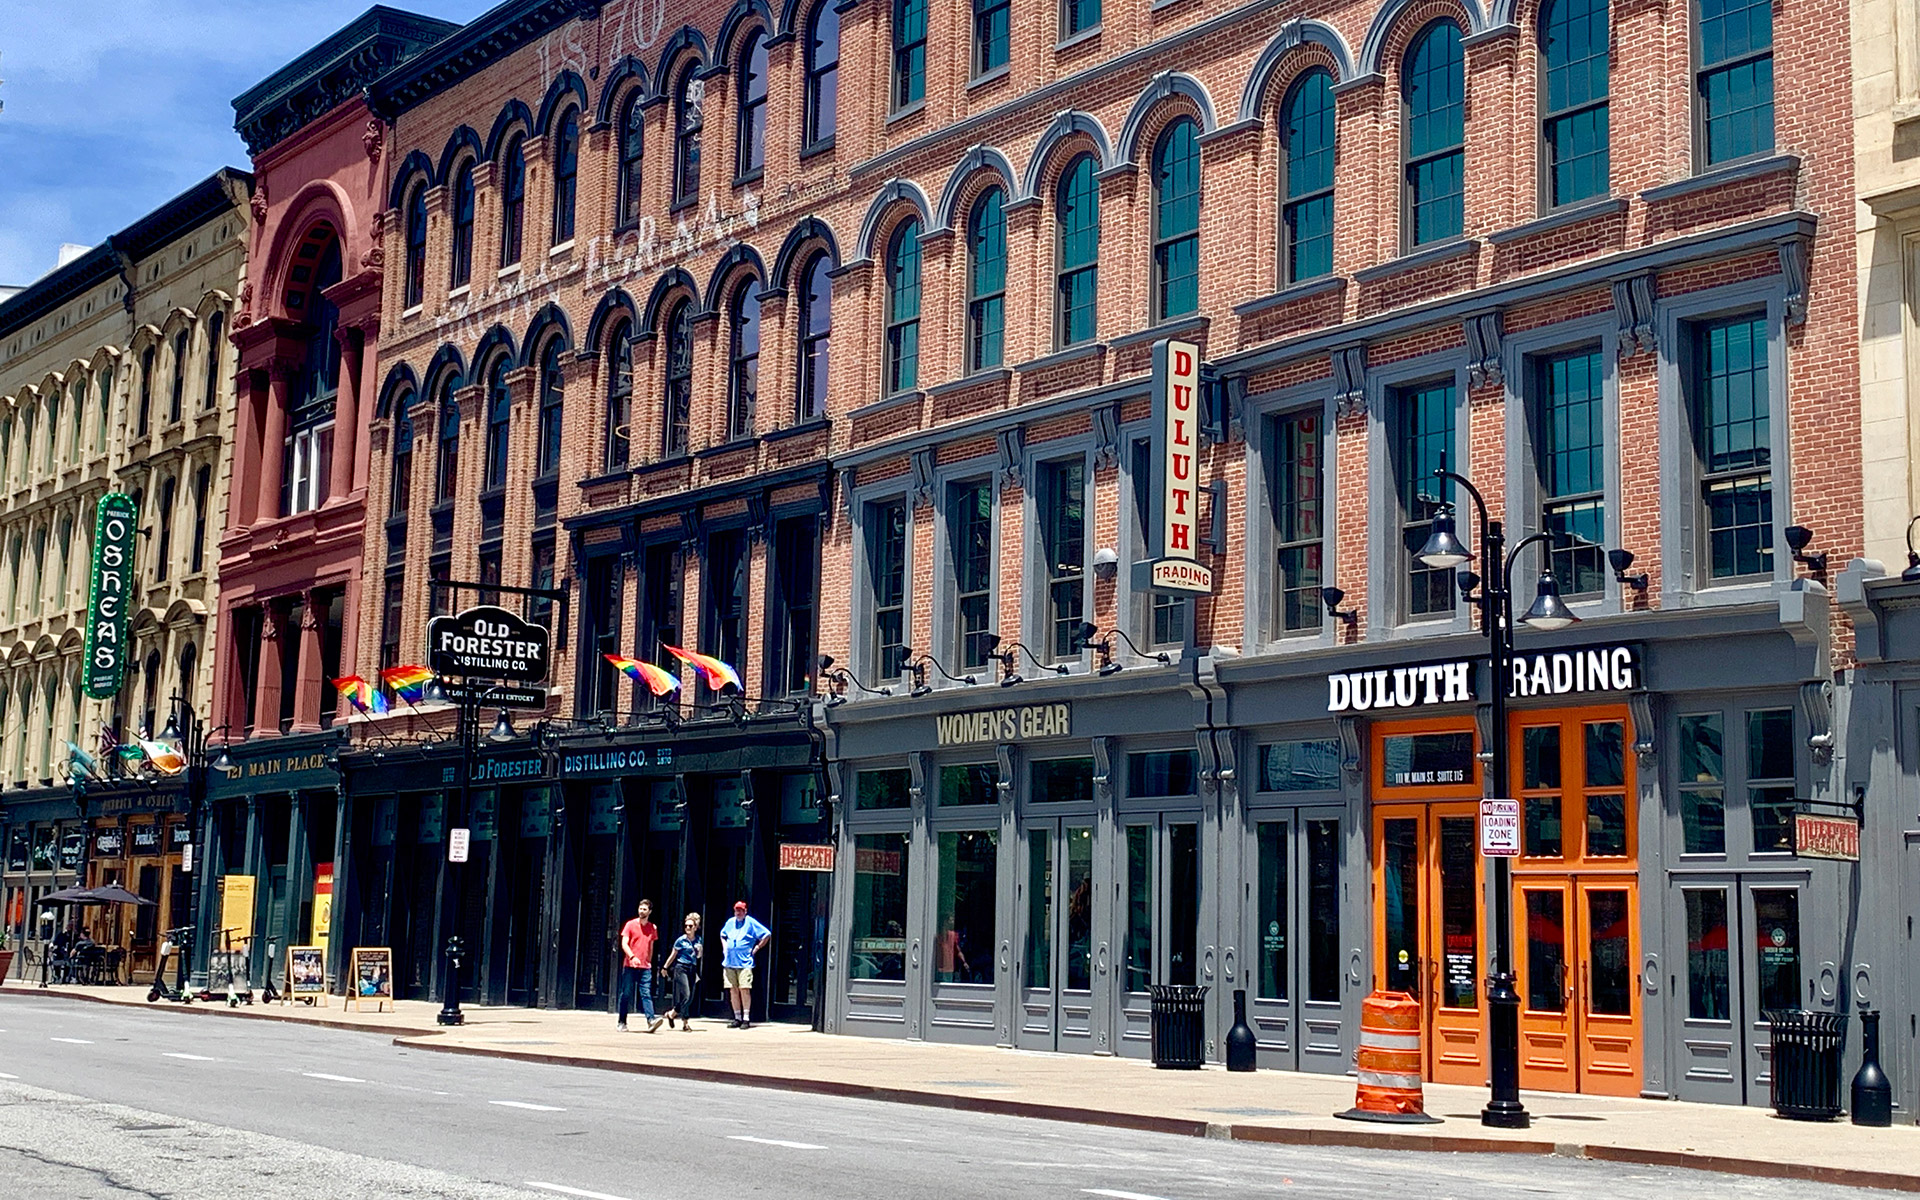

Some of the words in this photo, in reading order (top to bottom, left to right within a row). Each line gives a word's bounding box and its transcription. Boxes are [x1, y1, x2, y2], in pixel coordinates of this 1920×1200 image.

[1171, 350, 1191, 550] DULUTH
[1155, 566, 1209, 586] TRADING
[474, 619, 509, 638] OLD
[442, 631, 541, 660] FORESTER
[511, 661, 528, 670] CO.
[1328, 662, 1470, 712] DULUTH
[937, 709, 1016, 745] WOMEN'S
[1020, 704, 1068, 738] GEAR
[249, 760, 281, 776] MAIN
[287, 754, 325, 771] PLACE
[487, 759, 542, 779] FORESTER
[565, 751, 626, 772] DISTILLING
[629, 750, 648, 767] CO.
[1411, 771, 1426, 783] MAIN
[1437, 770, 1453, 782] SUITE
[1454, 769, 1463, 781] 115
[1483, 802, 1492, 814] NO
[1493, 804, 1516, 813] PARKING
[1484, 817, 1516, 828] LOADING
[1489, 829, 1512, 839] ZONE
